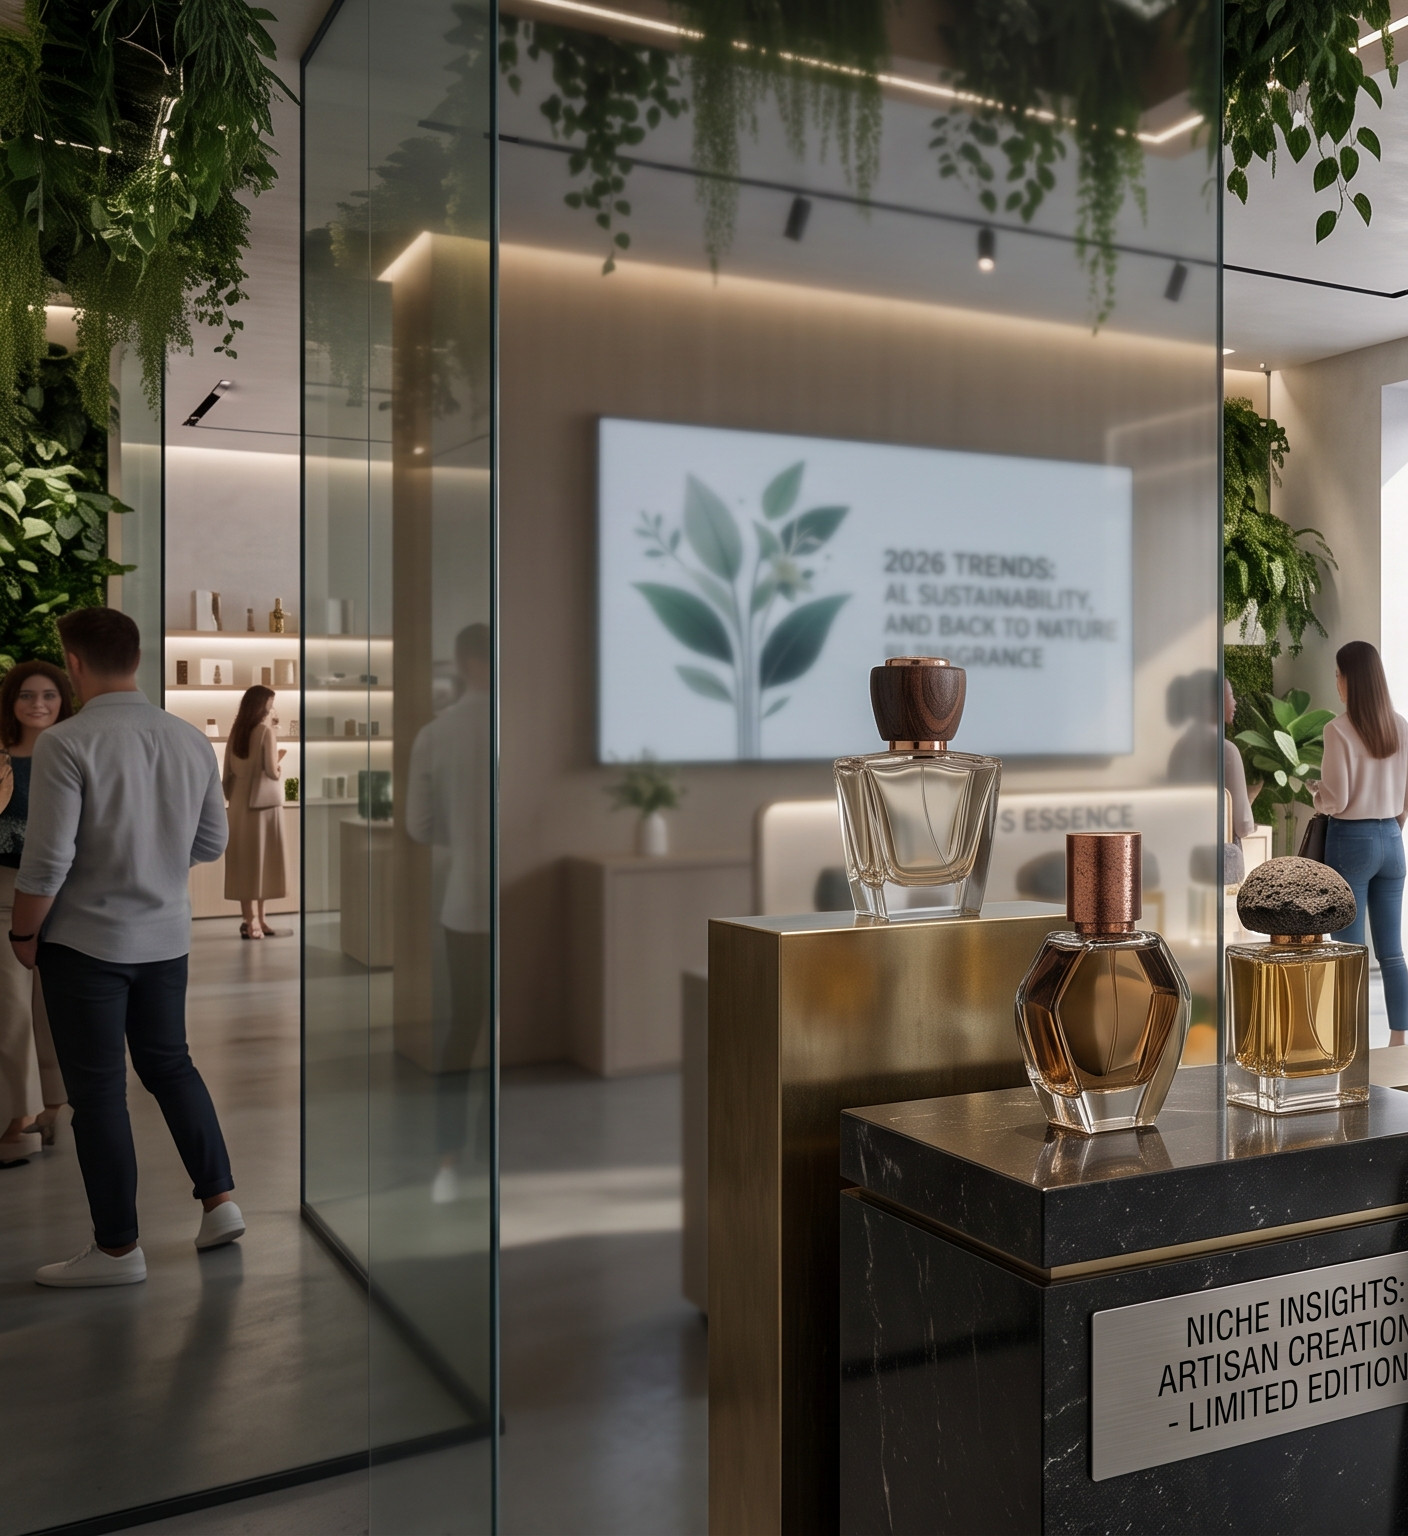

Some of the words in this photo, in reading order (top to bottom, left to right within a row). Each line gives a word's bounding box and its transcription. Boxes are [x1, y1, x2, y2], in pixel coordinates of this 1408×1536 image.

[884, 550, 945, 574] 2026
[954, 553, 1055, 579] TRENDS:
[919, 584, 1093, 615] SUSTAINABILITY,
[885, 613, 932, 635] AND
[939, 615, 996, 637] BACK
[1003, 618, 1030, 638] TO
[1037, 619, 1117, 642] NATURE
[914, 644, 1043, 668] GRANCE
[1024, 804, 1132, 832] ESSENCE
[1187, 1302, 1270, 1347] NICHE
[1280, 1276, 1405, 1328] INSIGHTS:
[1158, 1341, 1278, 1397] ARTISAN
[1189, 1379, 1298, 1432] LIMITED
